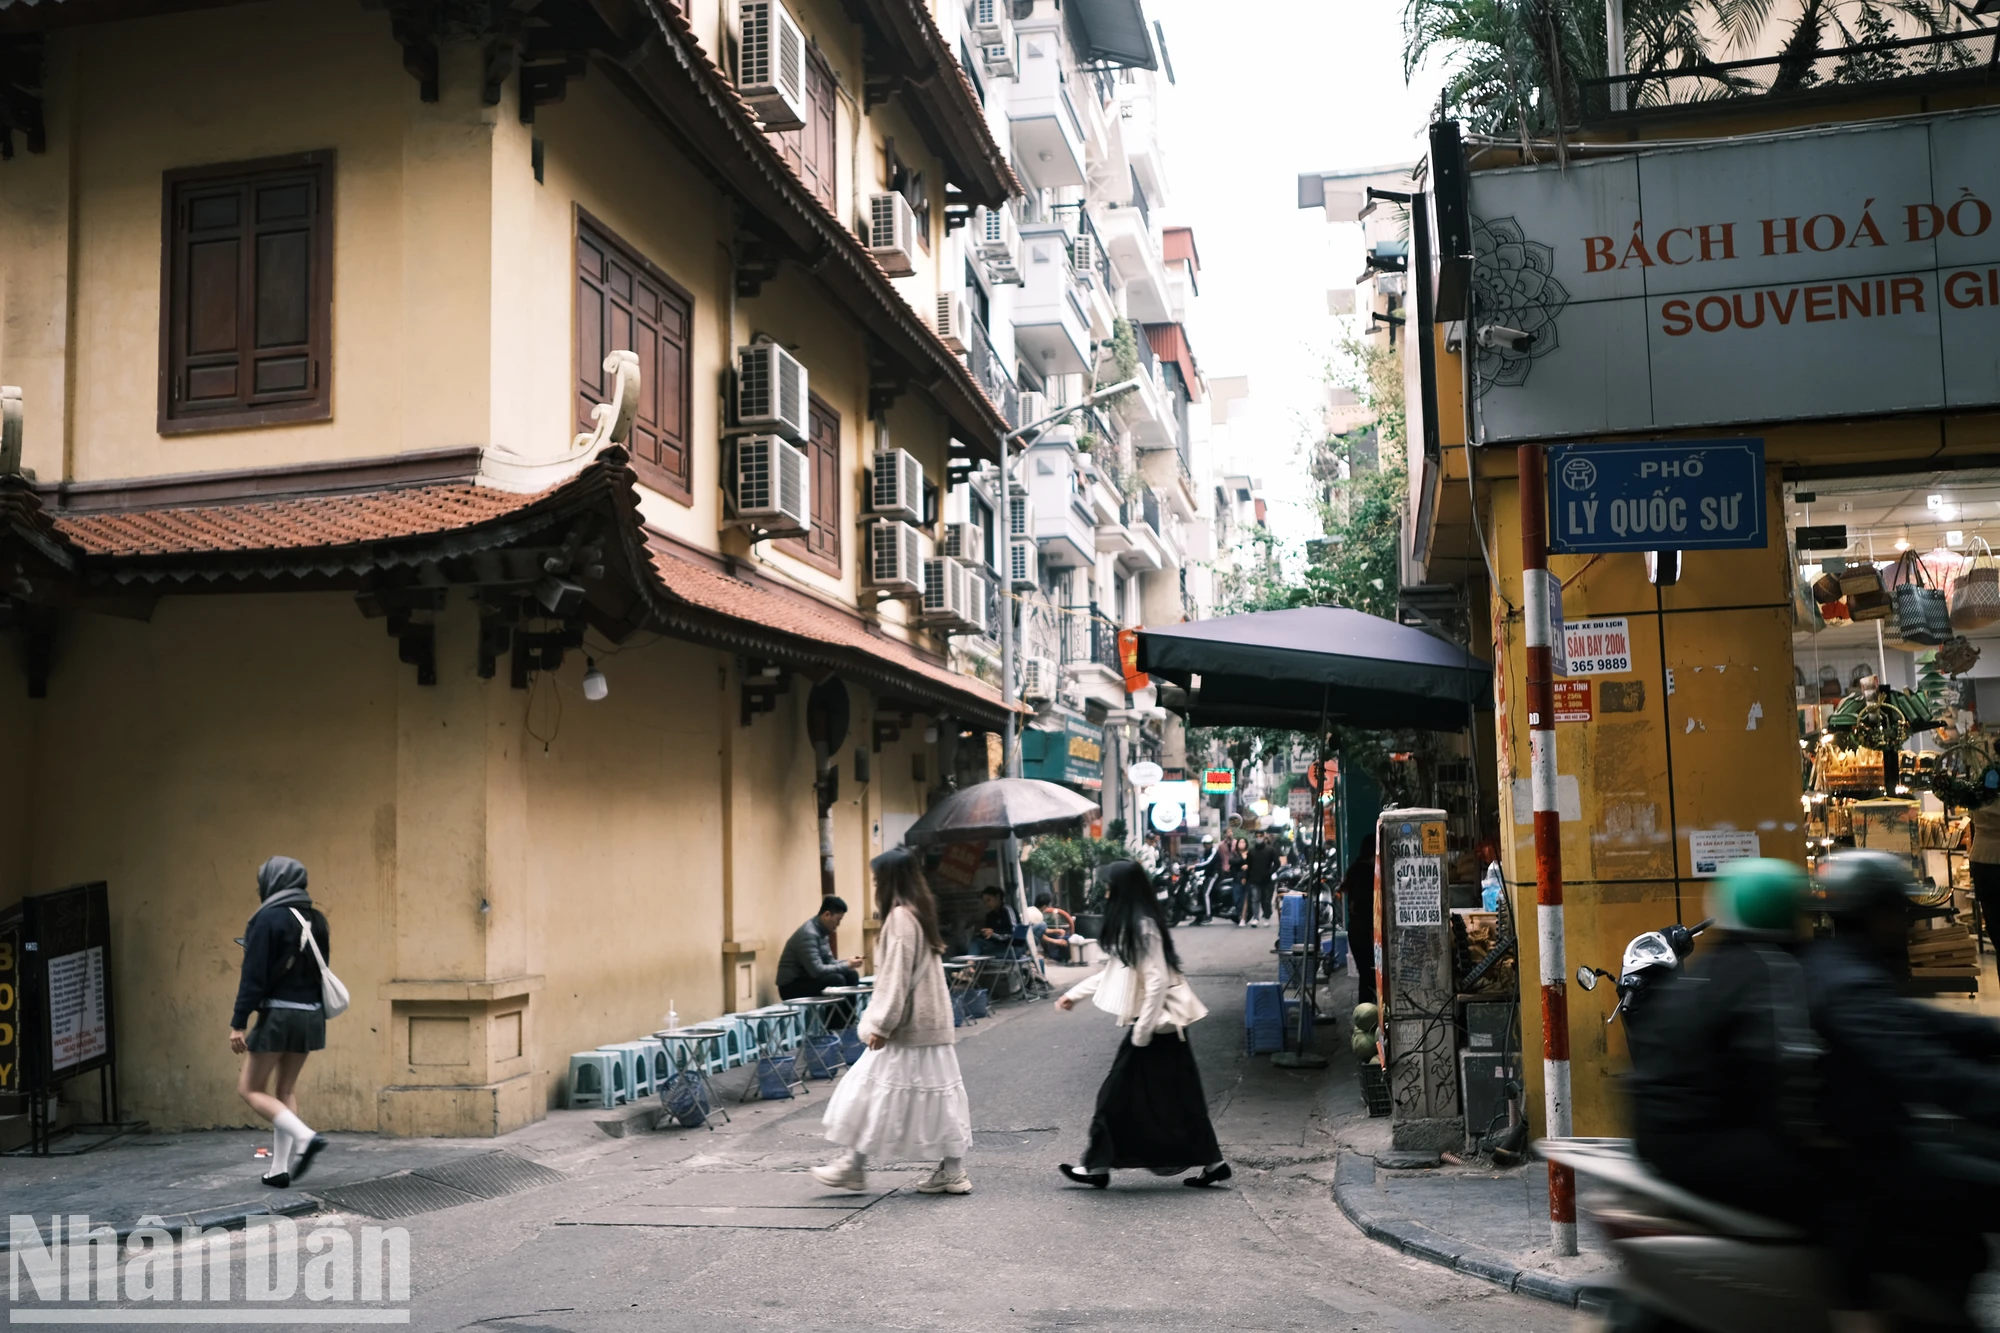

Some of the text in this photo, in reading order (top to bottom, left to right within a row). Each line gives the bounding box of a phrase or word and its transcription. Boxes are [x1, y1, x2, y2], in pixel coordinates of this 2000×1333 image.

[1580, 187, 1992, 273] BÁCH HOÁ ĐỒ
[1660, 276, 1926, 337] SOUVENIR
[1640, 451, 1707, 479] PHỐ
[1568, 486, 1743, 537] LÝ QUỐC SƯ
[1605, 620, 1623, 629] LỊCH
[1567, 632, 1586, 659] SÂN
[1587, 634, 1603, 657] BAY
[1604, 632, 1627, 655] 200k
[1571, 657, 1628, 673] 365 9889
[1418, 862, 1439, 878] NHÀ
